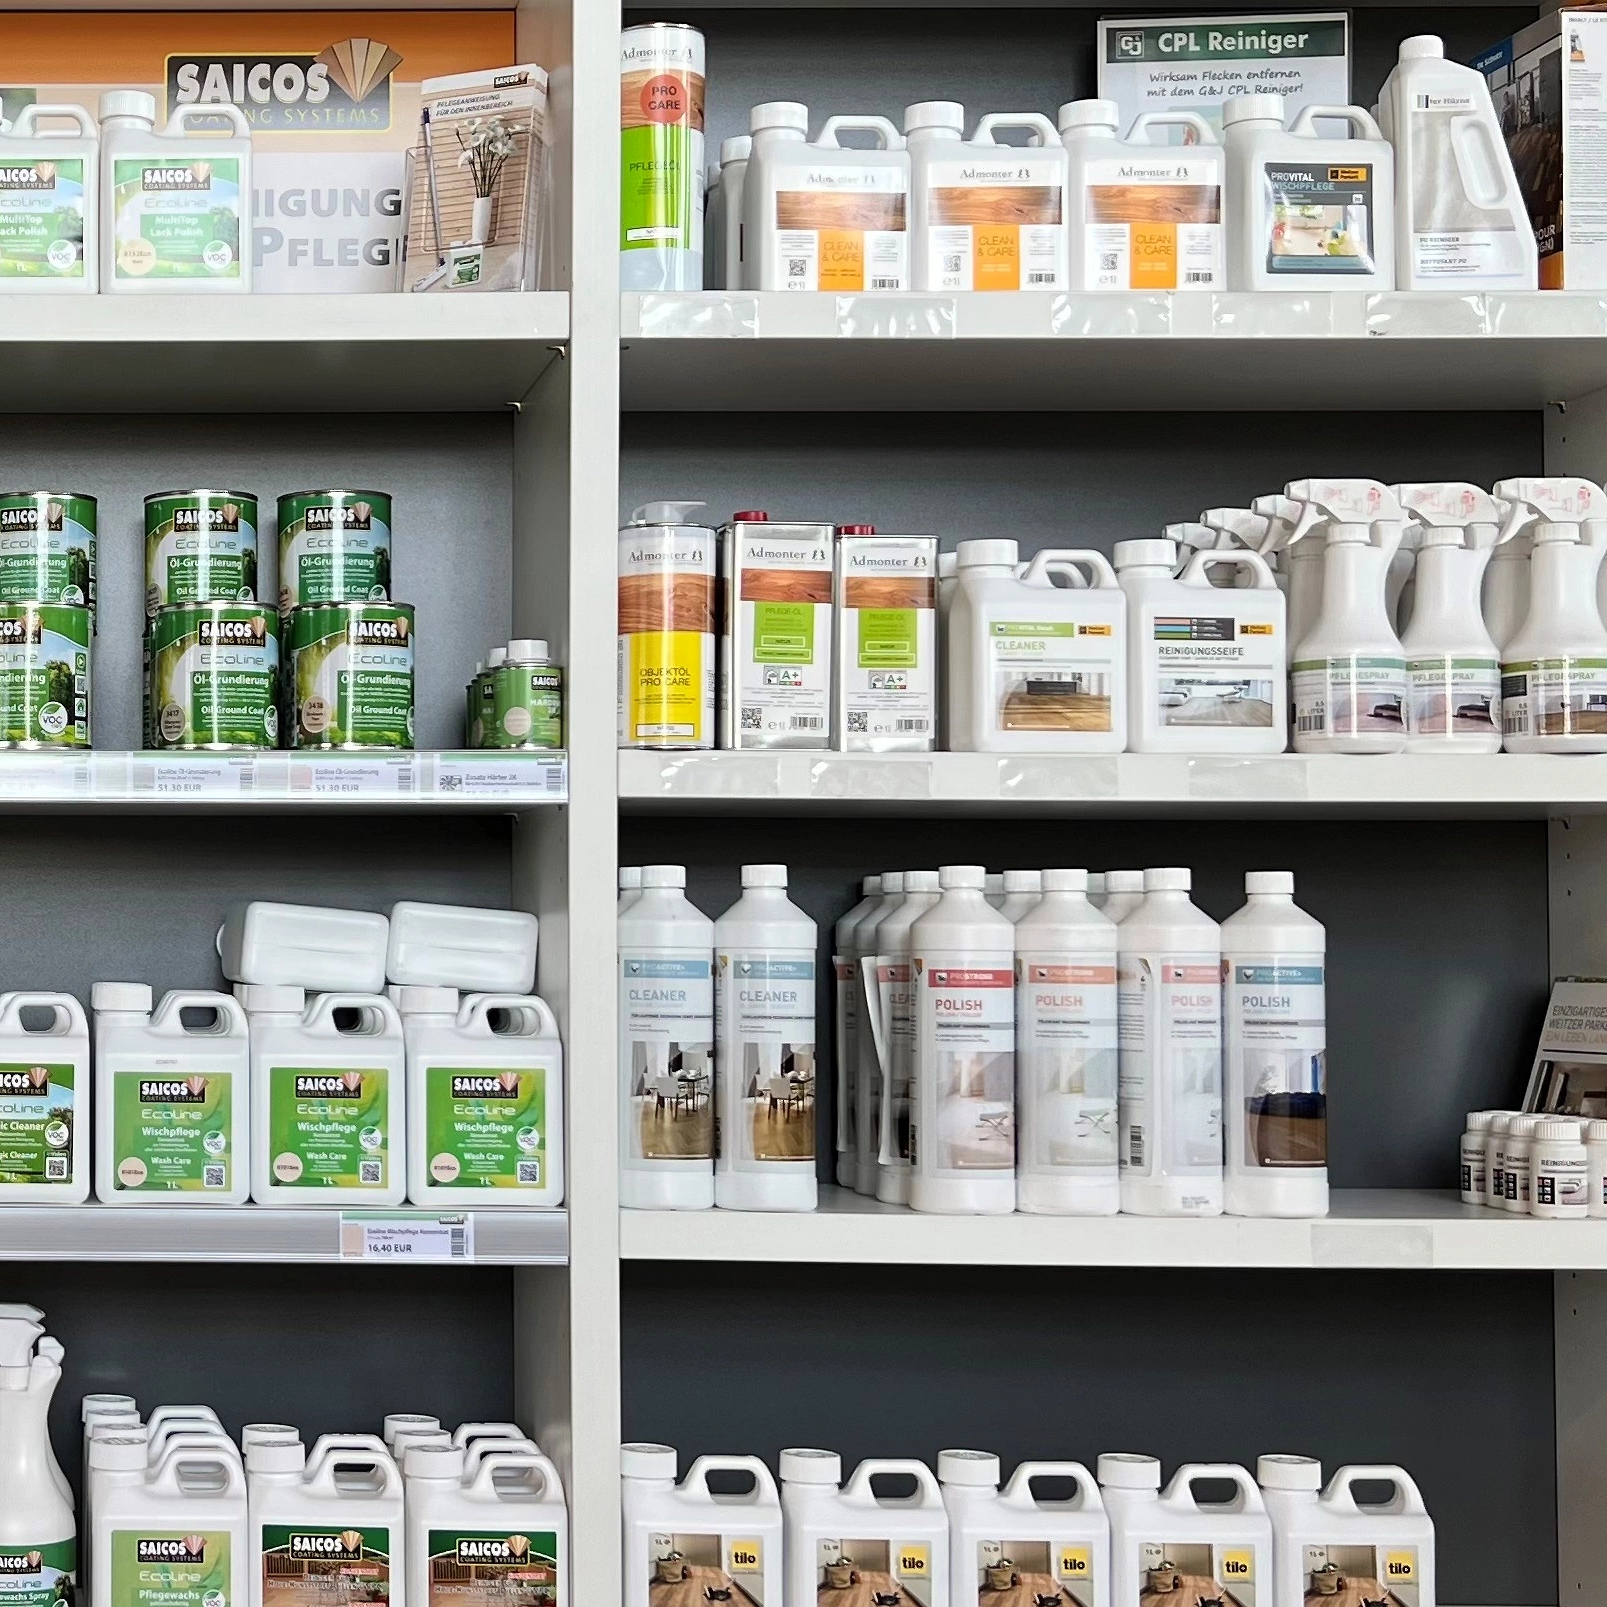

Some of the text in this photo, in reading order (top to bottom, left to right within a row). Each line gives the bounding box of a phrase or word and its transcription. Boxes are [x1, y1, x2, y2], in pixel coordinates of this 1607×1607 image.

[1158, 29, 1310, 54] CPL Reiniger
[1149, 69, 1301, 82] Wirksam Flecken entfernen
[176, 63, 330, 104] SAICOS
[651, 86, 678, 97] PRO
[1147, 86, 1166, 96] mit
[1170, 85, 1195, 96] dem
[1199, 85, 1224, 96] G&J
[1228, 85, 1251, 95] CPL
[648, 100, 681, 111] CARE
[284, 108, 380, 124] SYSTEMS
[960, 168, 1014, 179] Admonter
[1118, 166, 1172, 178] Admonter
[1271, 172, 1314, 181] PROVITAL
[0, 215, 42, 225] MultiTop
[155, 216, 198, 225] MultiTop
[19, 227, 48, 236] Polish
[150, 227, 203, 236] Lack Polish
[978, 236, 1014, 246] CLEAN
[1135, 235, 1172, 244] CLEAN
[823, 241, 859, 251] CLEAN
[986, 246, 1016, 256] CARE
[832, 251, 860, 262] CARE
[747, 546, 806, 560] Admonter
[850, 555, 908, 567] Admonter
[995, 641, 1046, 651] CLEANER
[1158, 646, 1244, 656] REINIGUNGSSEIFE
[200, 653, 264, 666] EcoLine
[781, 671, 799, 681] A+
[886, 673, 904, 683] A+
[640, 677, 690, 687] PRO CARE
[201, 705, 264, 715] Oil Ground Coat
[42, 716, 62, 724] VOC
[629, 990, 686, 1001] CLEANER
[739, 991, 797, 1002] CLEANER
[1035, 994, 1083, 1007] POLISH
[935, 999, 983, 1011] POLISH
[1243, 996, 1290, 1008] POLISH
[1549, 1018, 1583, 1030] WEITZER
[10, 1120, 45, 1131] Cleaner
[297, 1121, 357, 1134] Wischpflege
[142, 1126, 201, 1139] Wischpflege
[293, 1536, 342, 1551] SAICOS
[460, 1541, 510, 1556] SAICOS
[733, 1551, 756, 1565] tilo
[902, 1556, 924, 1570] tilo
[1063, 1558, 1085, 1572] tilo
[1226, 1559, 1248, 1574] tilo
[1388, 1561, 1411, 1576] tilo
[139, 1570, 201, 1582] EcoLine
[139, 1589, 200, 1601] Pflegewachs
